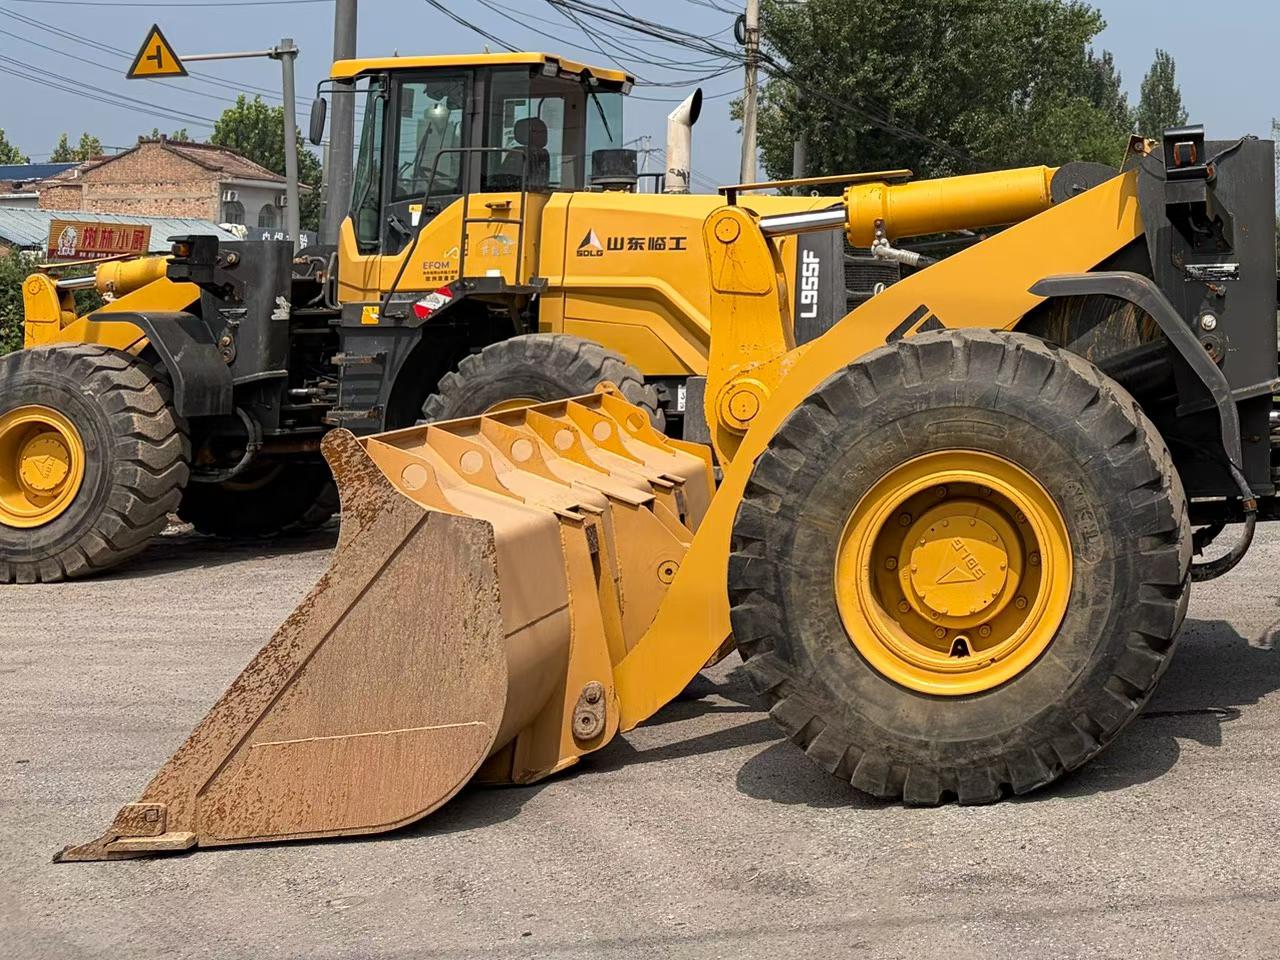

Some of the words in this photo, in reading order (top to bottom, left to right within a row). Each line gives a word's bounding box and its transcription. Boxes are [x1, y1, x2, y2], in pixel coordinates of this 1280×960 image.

[606, 236, 688, 251] 山东临工
[576, 249, 604, 257] SDLG
[800, 249, 820, 318] L955F
